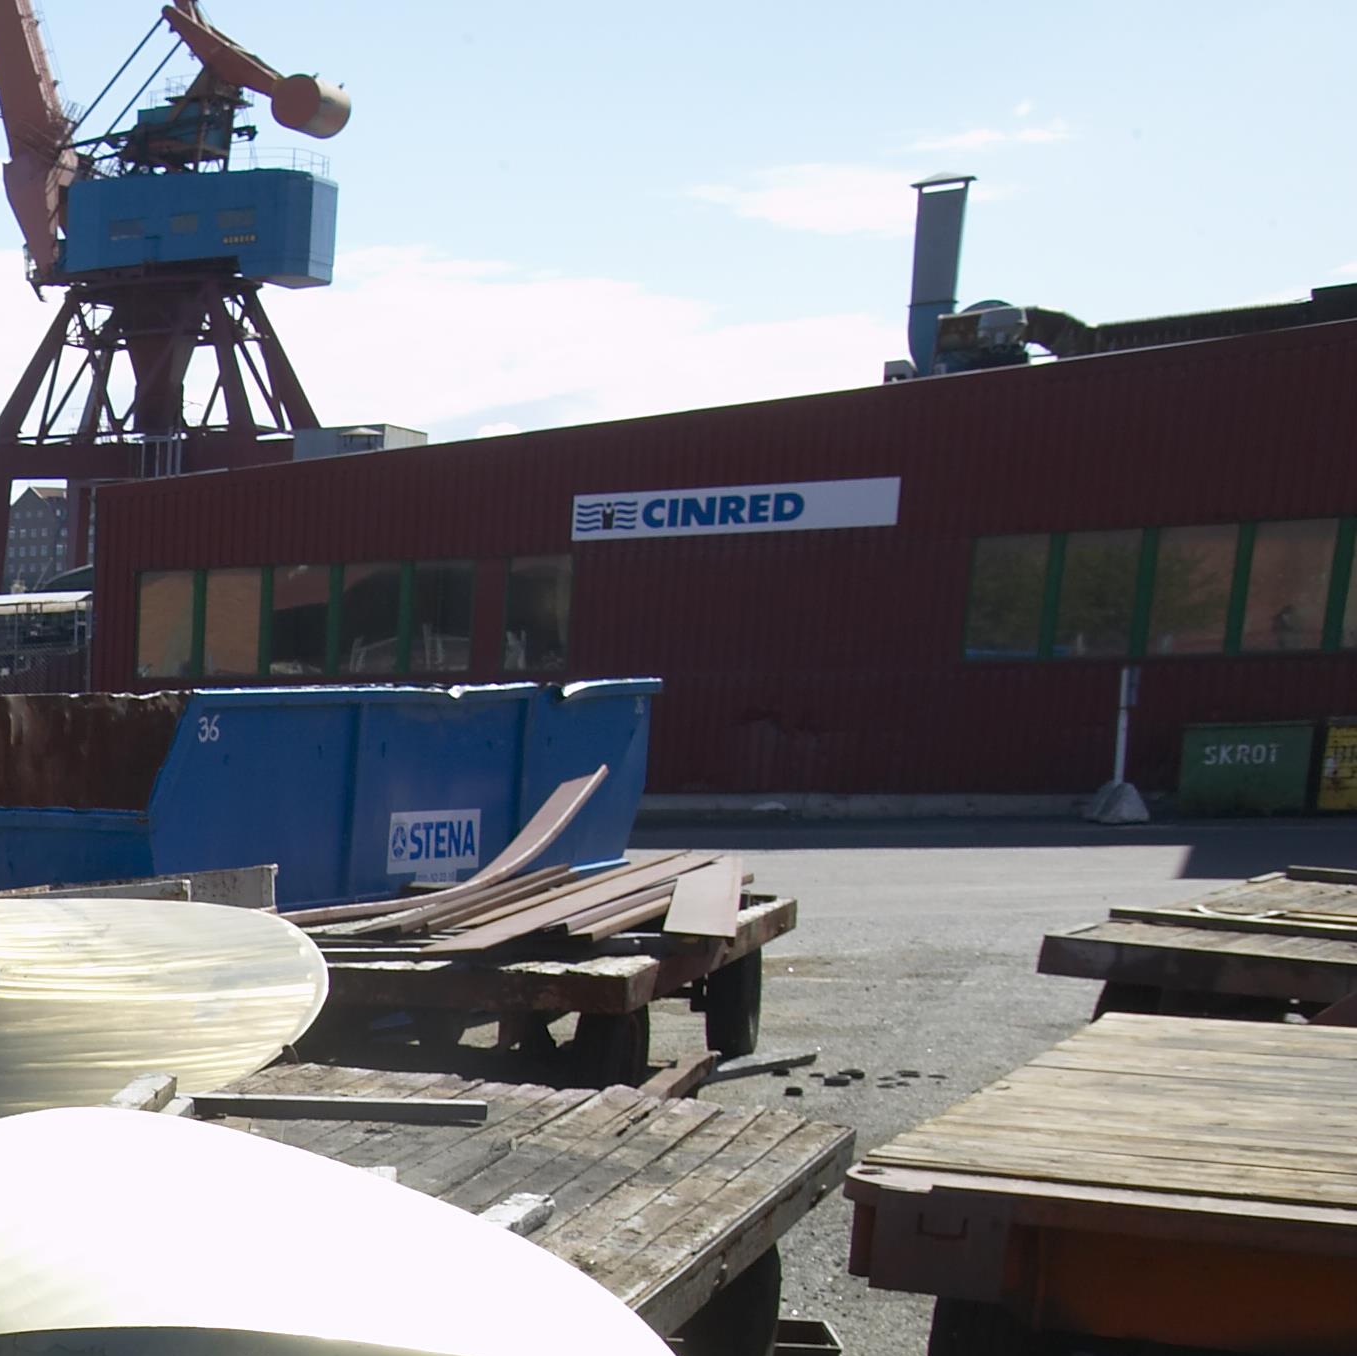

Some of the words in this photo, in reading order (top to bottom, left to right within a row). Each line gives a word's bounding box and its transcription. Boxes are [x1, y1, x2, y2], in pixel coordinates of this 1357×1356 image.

[642, 492, 805, 529] CINRED
[197, 713, 221, 743] 36
[1204, 743, 1282, 766] SKROT
[409, 820, 475, 860] STENA
